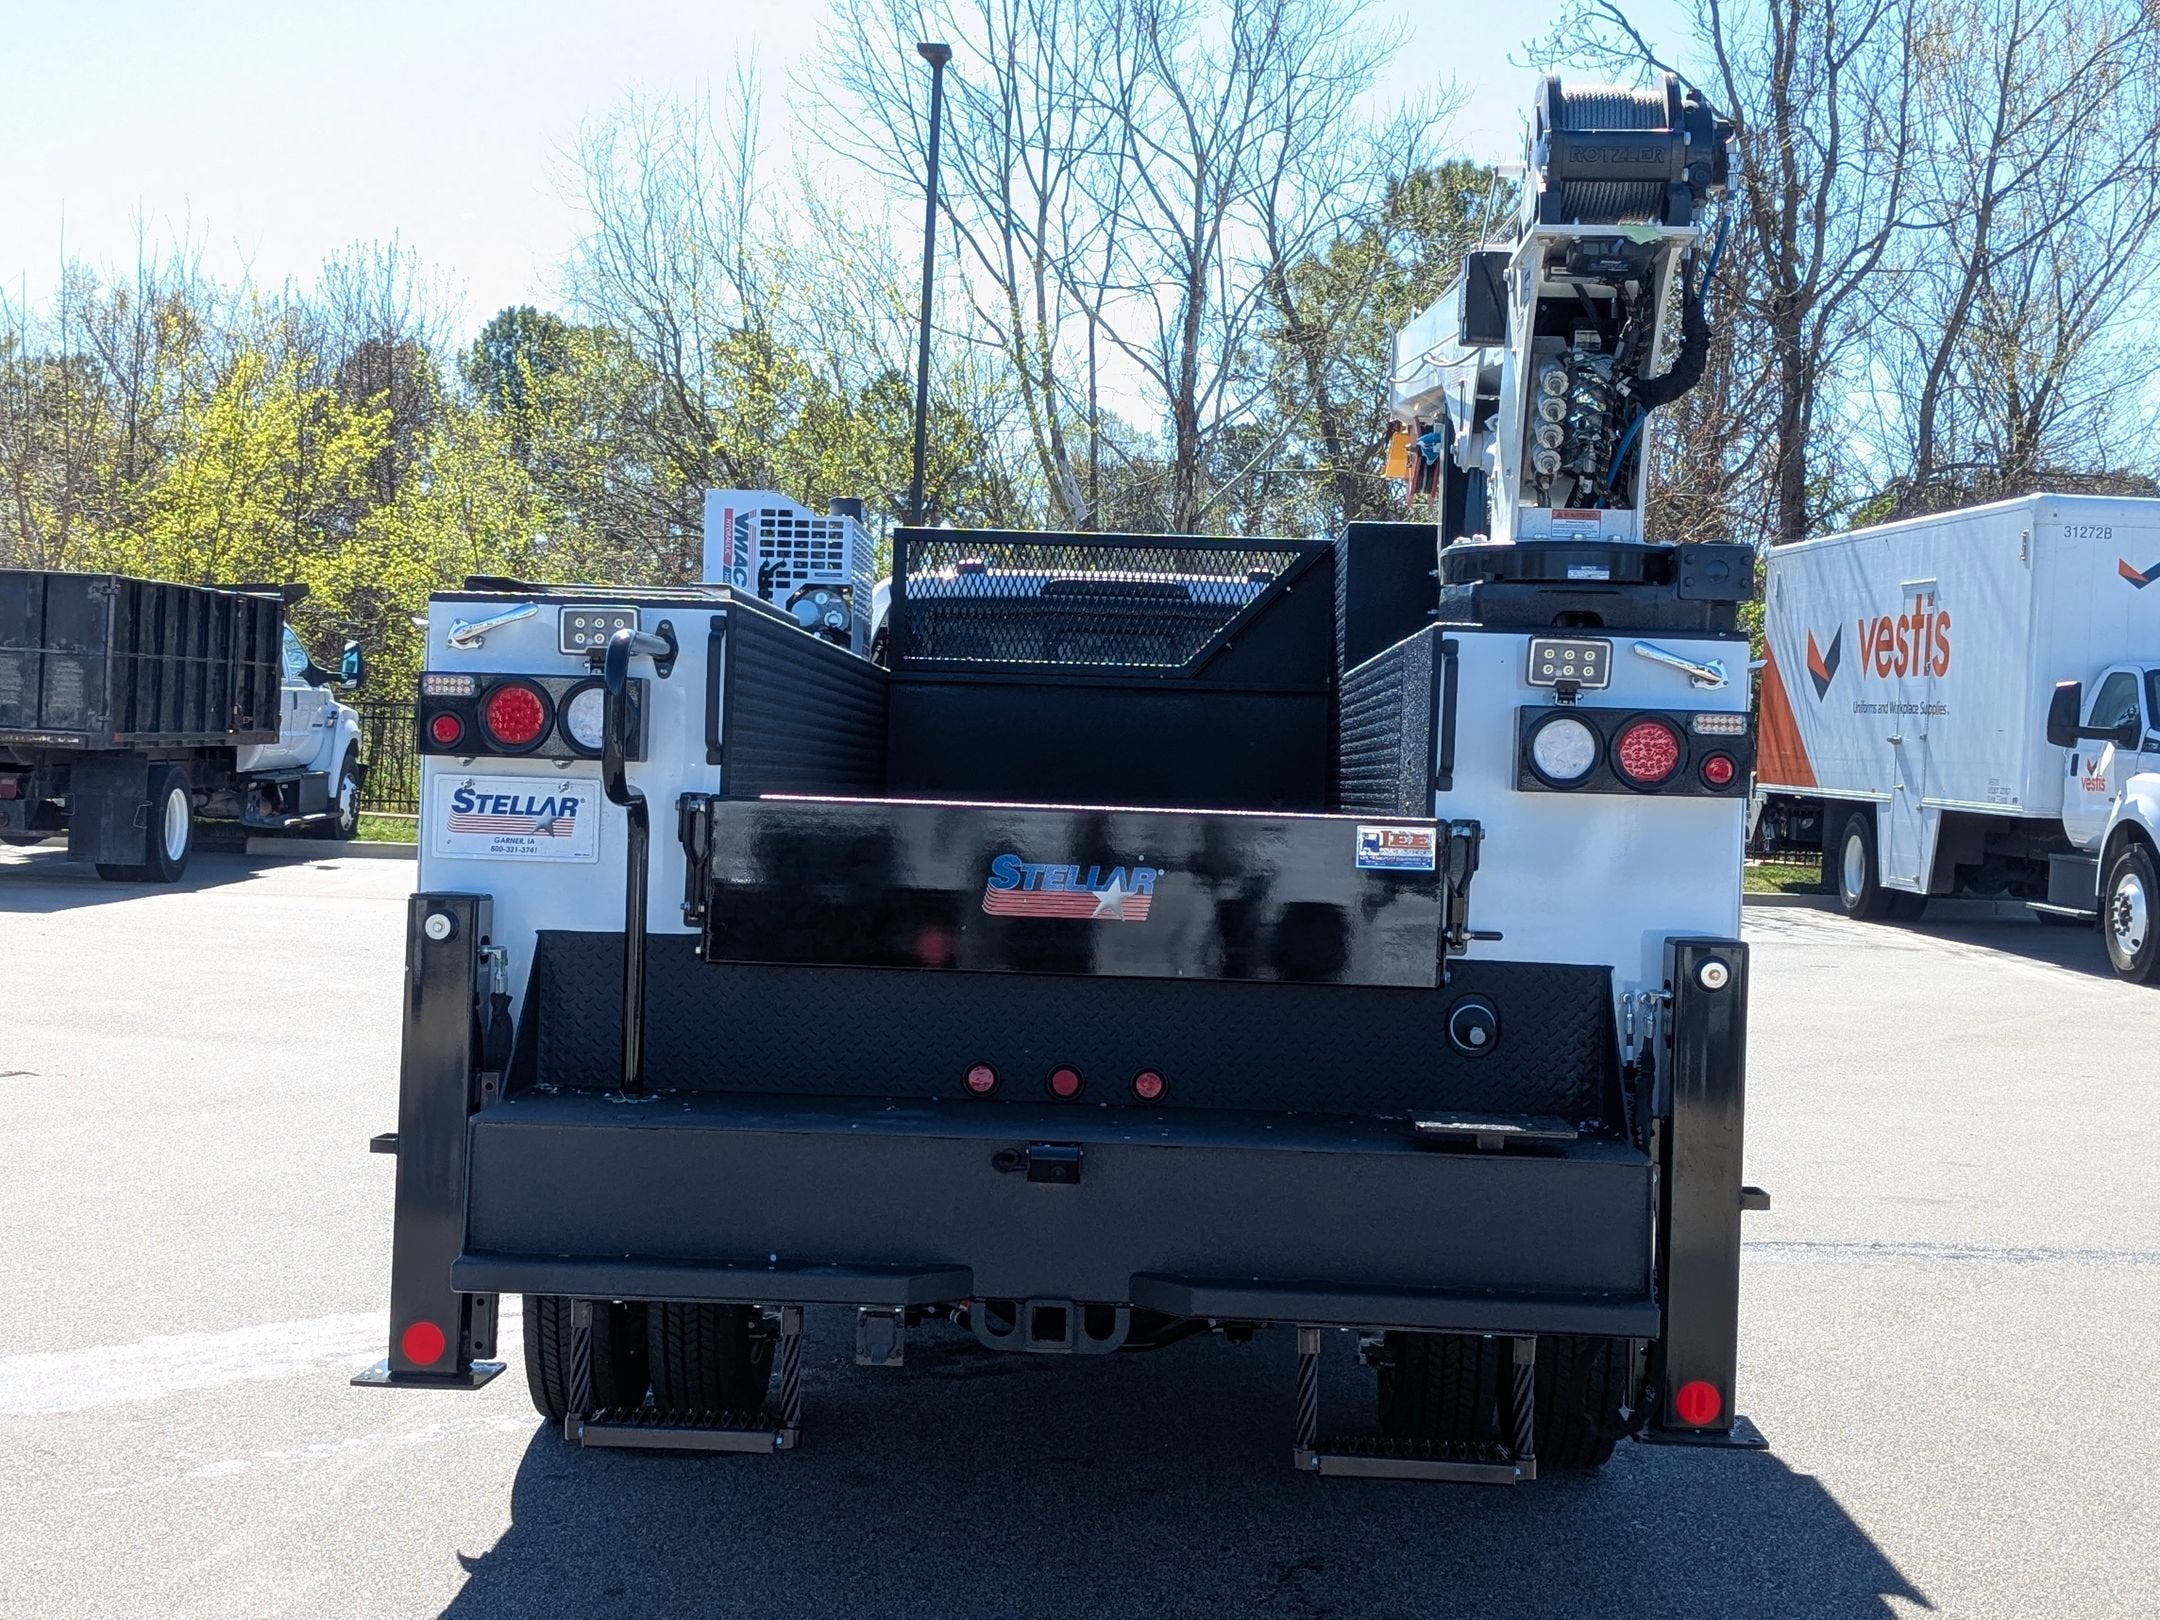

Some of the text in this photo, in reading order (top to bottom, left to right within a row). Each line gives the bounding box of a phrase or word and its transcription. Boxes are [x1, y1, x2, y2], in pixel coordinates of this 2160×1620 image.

[1569, 145, 1665, 163] ROTZLER
[2063, 525, 2113, 540] 31272B
[733, 512, 749, 588] VMAC
[1858, 591, 1951, 680] vestis
[1853, 701, 1877, 714] Uniforms
[1878, 701, 1889, 714] and
[1890, 701, 1919, 717] Workplace
[2081, 775, 2106, 792] vestis
[527, 837, 535, 845] IA
